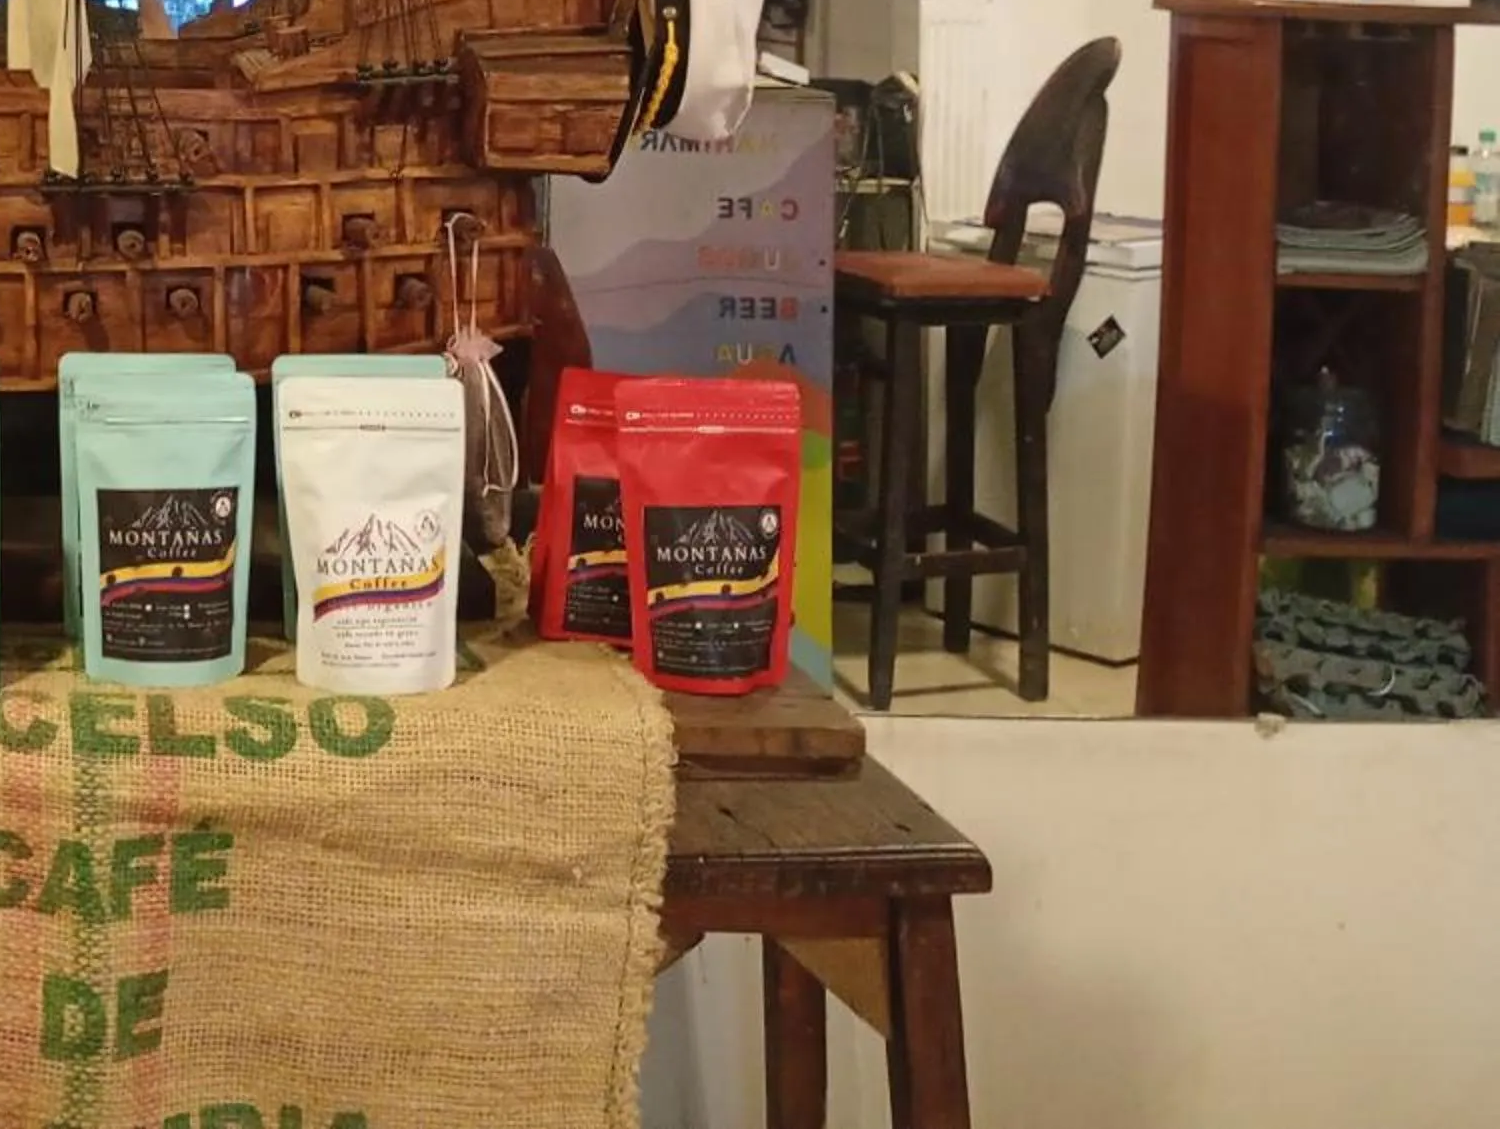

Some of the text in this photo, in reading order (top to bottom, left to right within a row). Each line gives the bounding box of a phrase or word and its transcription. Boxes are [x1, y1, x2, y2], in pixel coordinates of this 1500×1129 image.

[109, 527, 222, 547] MONTAÑAS
[657, 542, 767, 562] MONTAÑAS
[316, 553, 440, 575] MONTAÑAS
[40, 970, 169, 1062] DE
